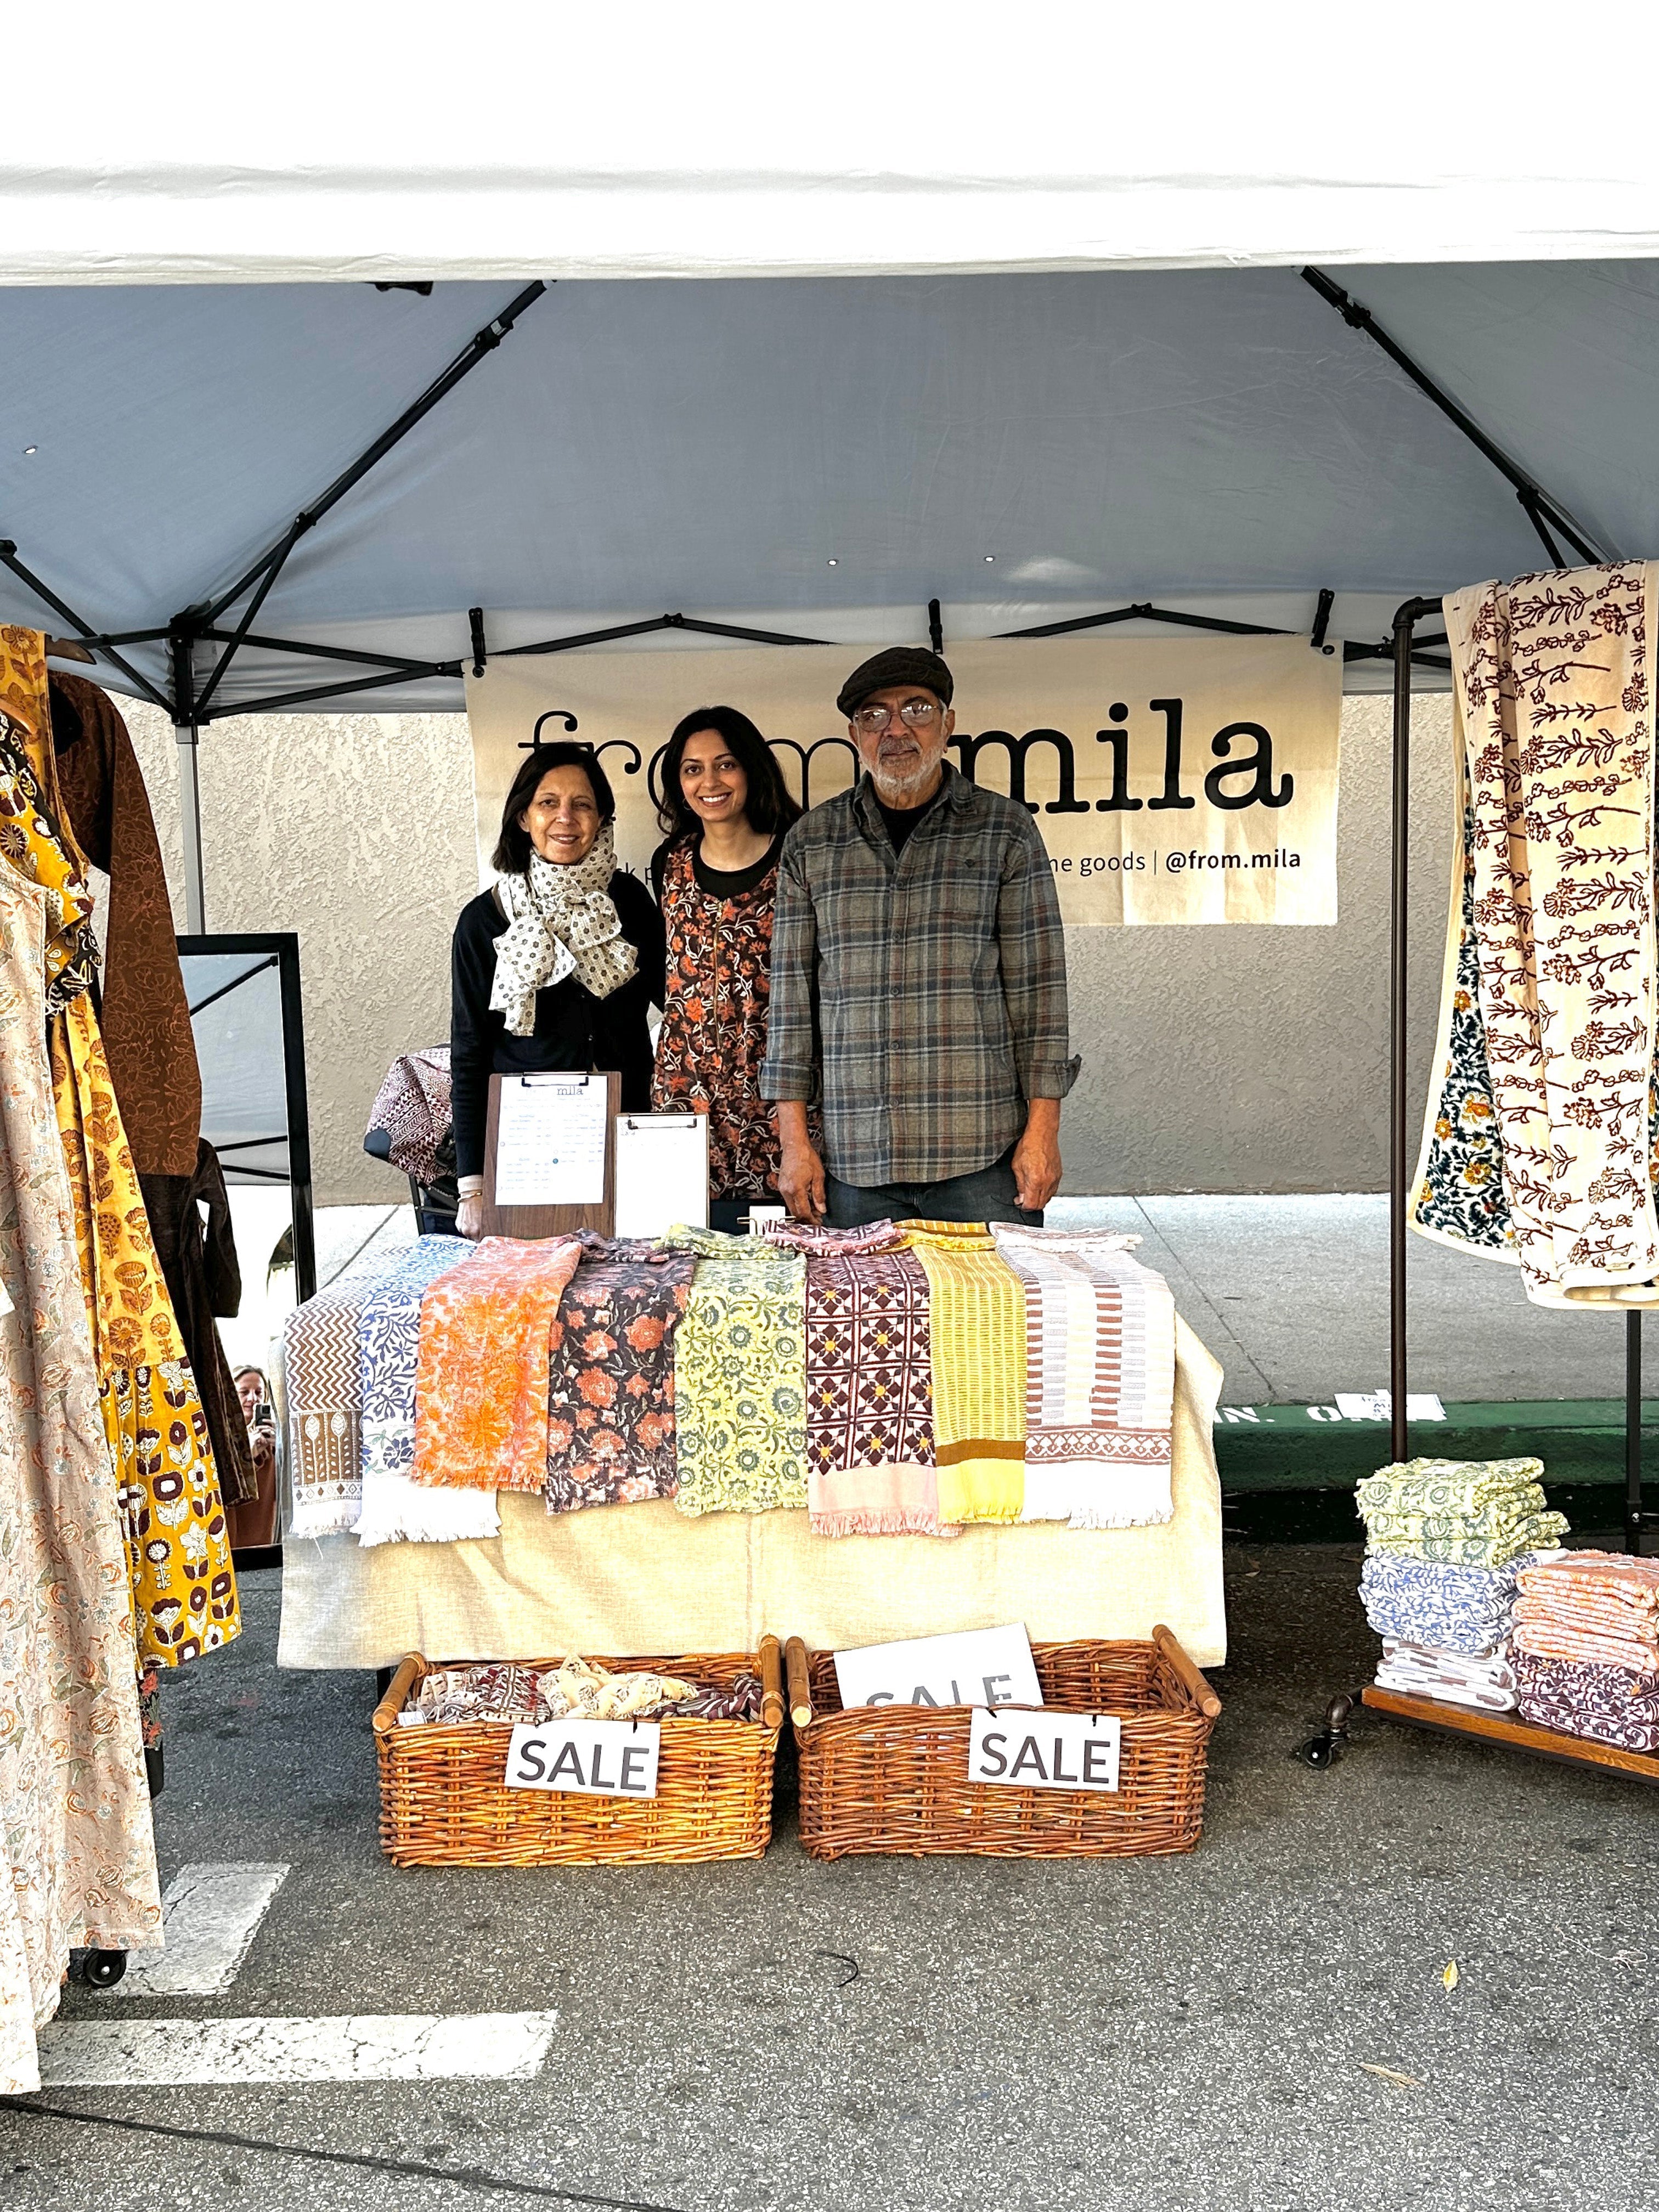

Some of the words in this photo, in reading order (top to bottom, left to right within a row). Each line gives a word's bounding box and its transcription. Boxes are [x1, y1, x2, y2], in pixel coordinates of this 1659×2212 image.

[947, 698, 1294, 814] mila
[1080, 851, 1146, 877] goods
[1166, 849, 1301, 873] @from.mila
[516, 1740, 650, 1791] SALE
[979, 1733, 1110, 1784] SALE
